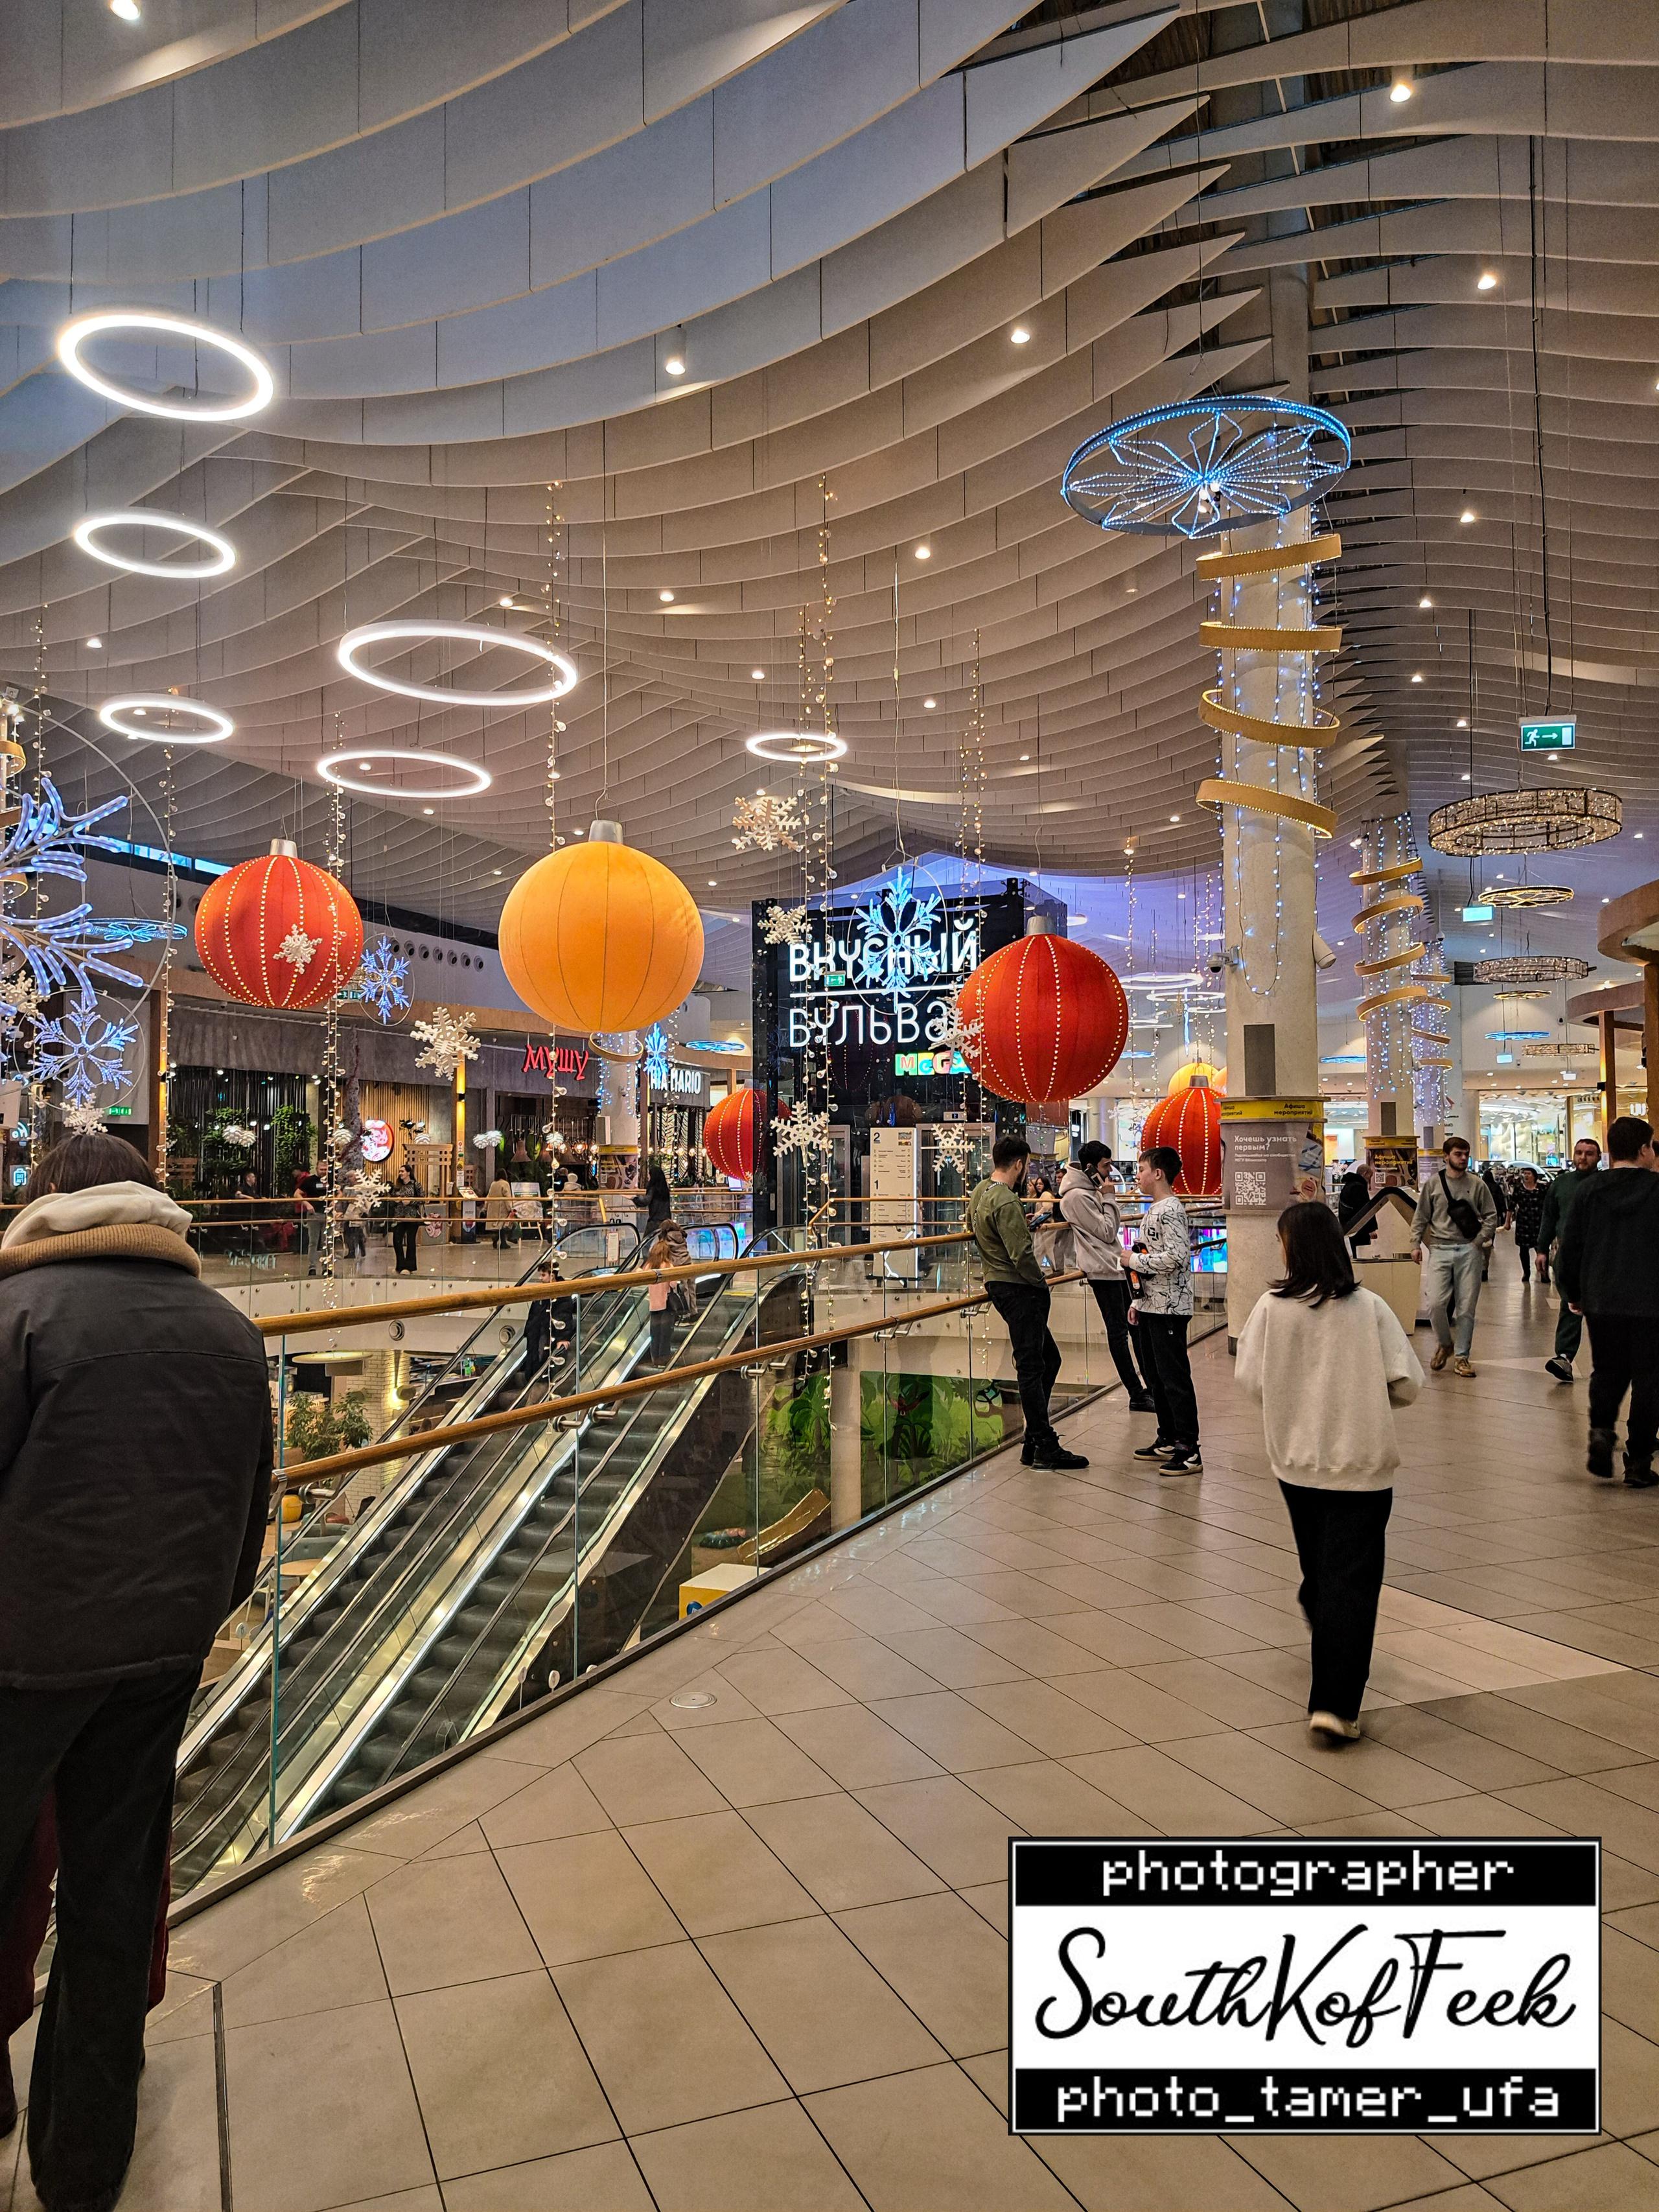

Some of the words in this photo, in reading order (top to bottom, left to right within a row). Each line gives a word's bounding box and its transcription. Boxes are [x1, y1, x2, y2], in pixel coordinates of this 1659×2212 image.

[523, 1043, 588, 1080] МУШУ
[670, 1068, 701, 1094] MARIO
[874, 1132, 880, 1142] 2
[1267, 1136, 1297, 1145] узнать
[874, 1180, 878, 1190] 1
